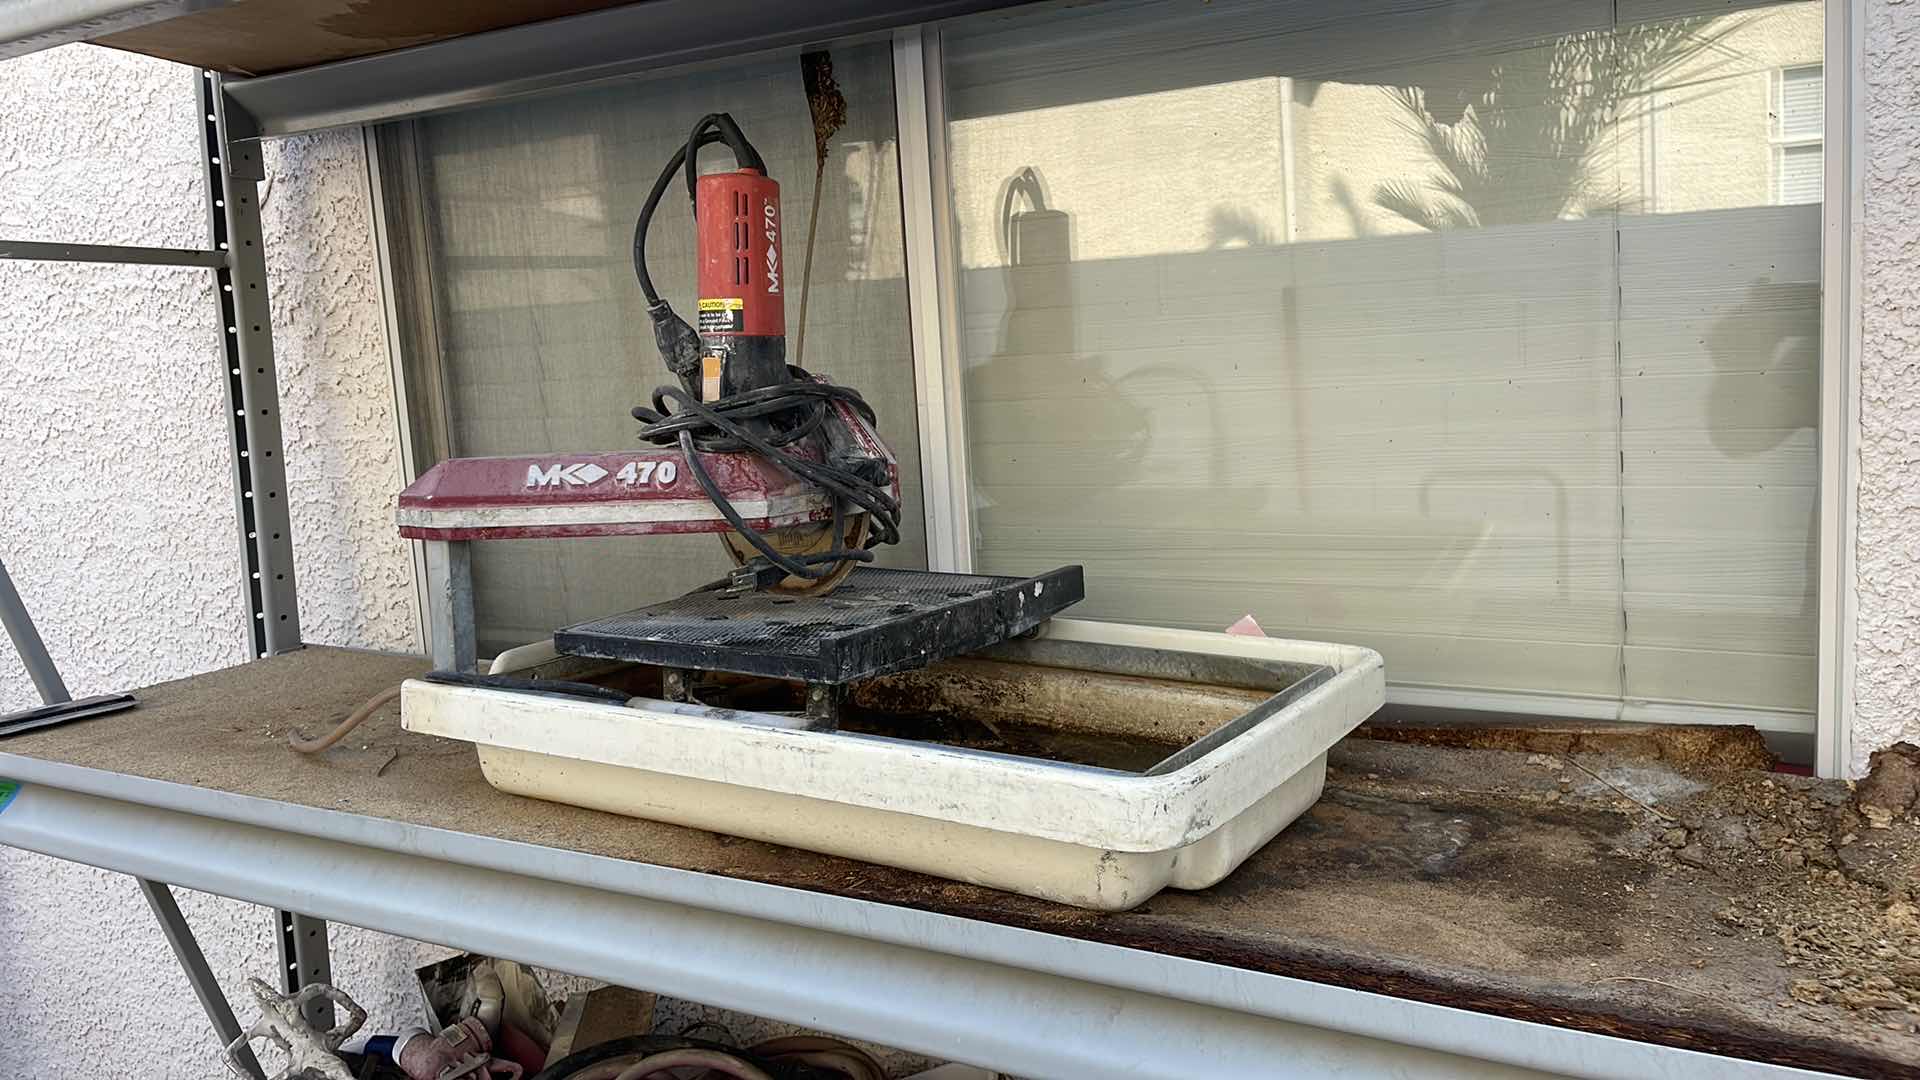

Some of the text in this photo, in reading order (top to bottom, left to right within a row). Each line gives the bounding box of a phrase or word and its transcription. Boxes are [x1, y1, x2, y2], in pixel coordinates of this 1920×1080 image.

[767, 259, 779, 293] MK
[527, 461, 677, 487] MK 470
